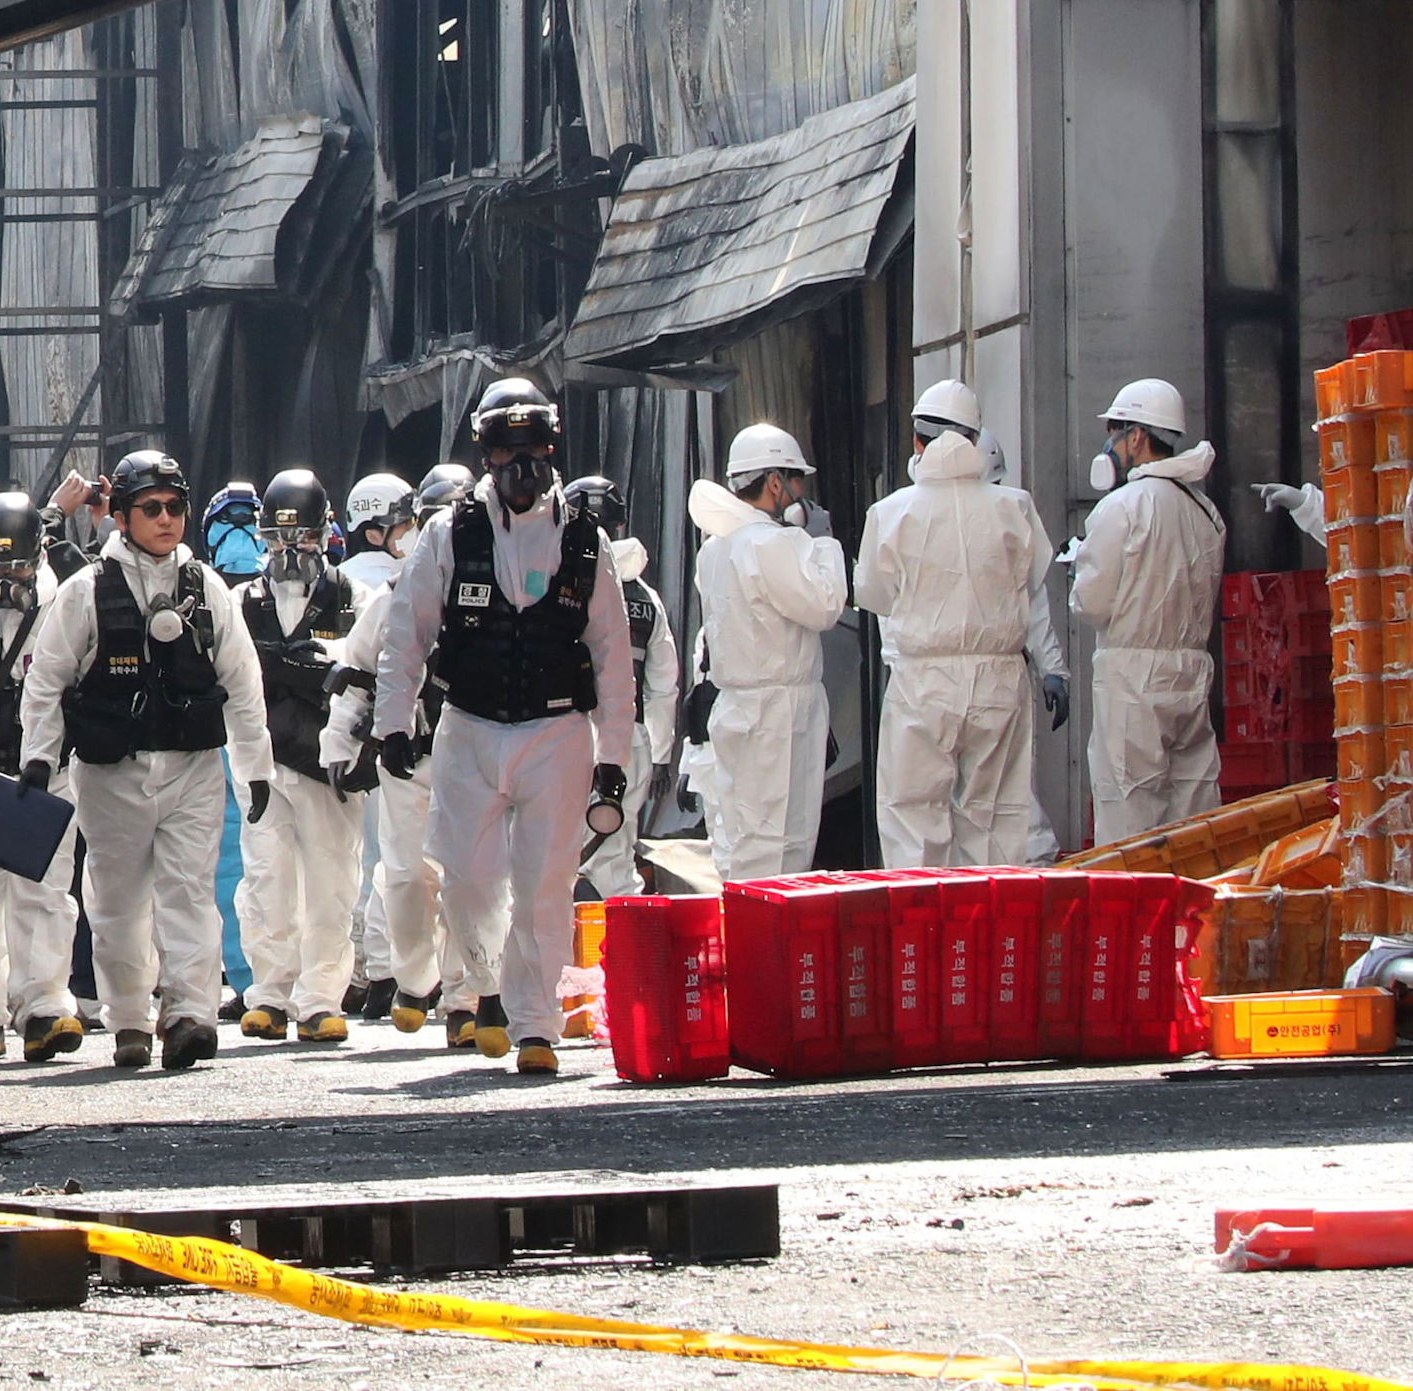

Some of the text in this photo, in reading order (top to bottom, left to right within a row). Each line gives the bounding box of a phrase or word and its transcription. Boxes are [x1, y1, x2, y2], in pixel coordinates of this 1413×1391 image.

[352, 498, 382, 512] 국과수
[109, 665, 139, 675] 과학수사
[684, 957, 702, 1022] 부적합품
[799, 953, 816, 1020] 부적합품
[901, 943, 917, 1010] 부적합품
[951, 939, 966, 1006] 부적합품
[999, 937, 1015, 1003] 부적합품
[1092, 936, 1108, 1001] 부적합품
[1280, 1024, 1341, 1038] 안전공업(주)
